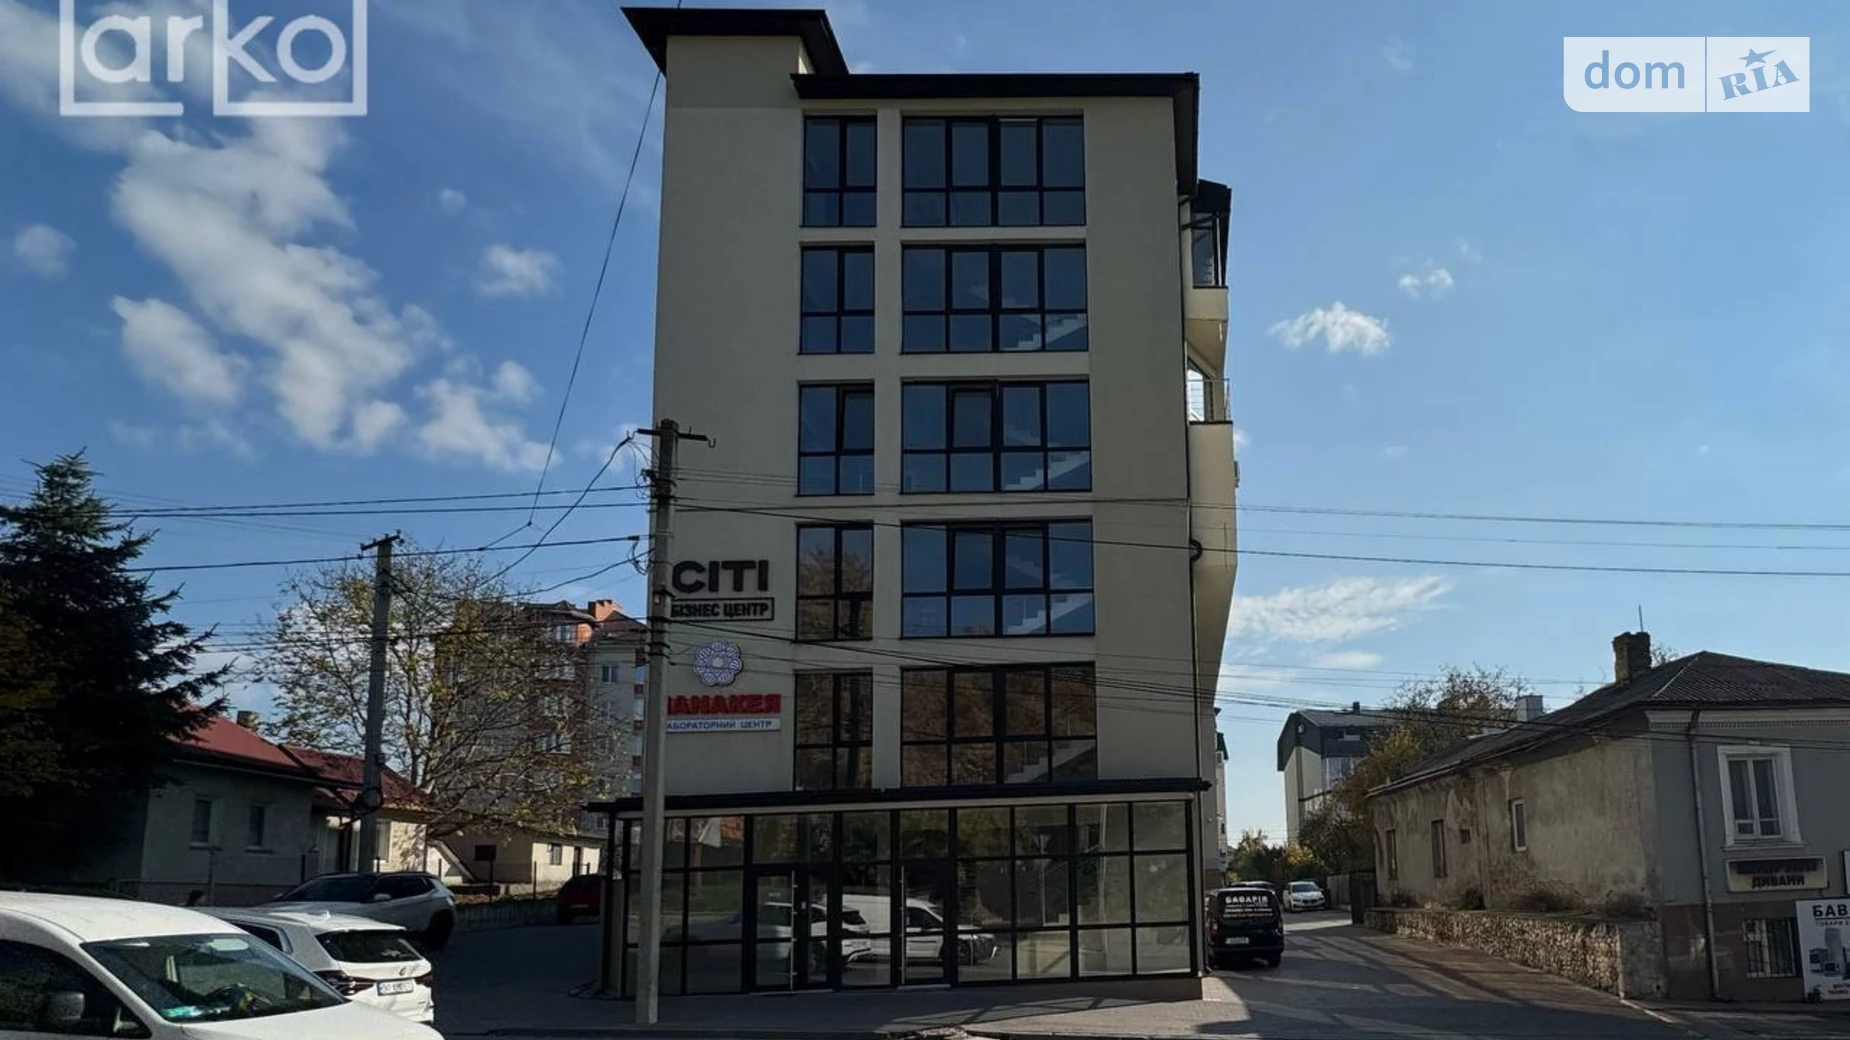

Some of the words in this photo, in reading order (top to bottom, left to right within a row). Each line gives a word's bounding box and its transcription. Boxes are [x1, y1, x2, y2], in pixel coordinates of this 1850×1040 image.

[670, 603, 720, 618] БІЗНЕС
[723, 602, 769, 618] ЦЕНТР
[665, 720, 737, 731] АБОРАТОРНИЙ
[740, 720, 773, 730] ЦЕНТР
[1751, 874, 1806, 889] ДИВАНИ
[1812, 903, 1850, 917] БАВ
